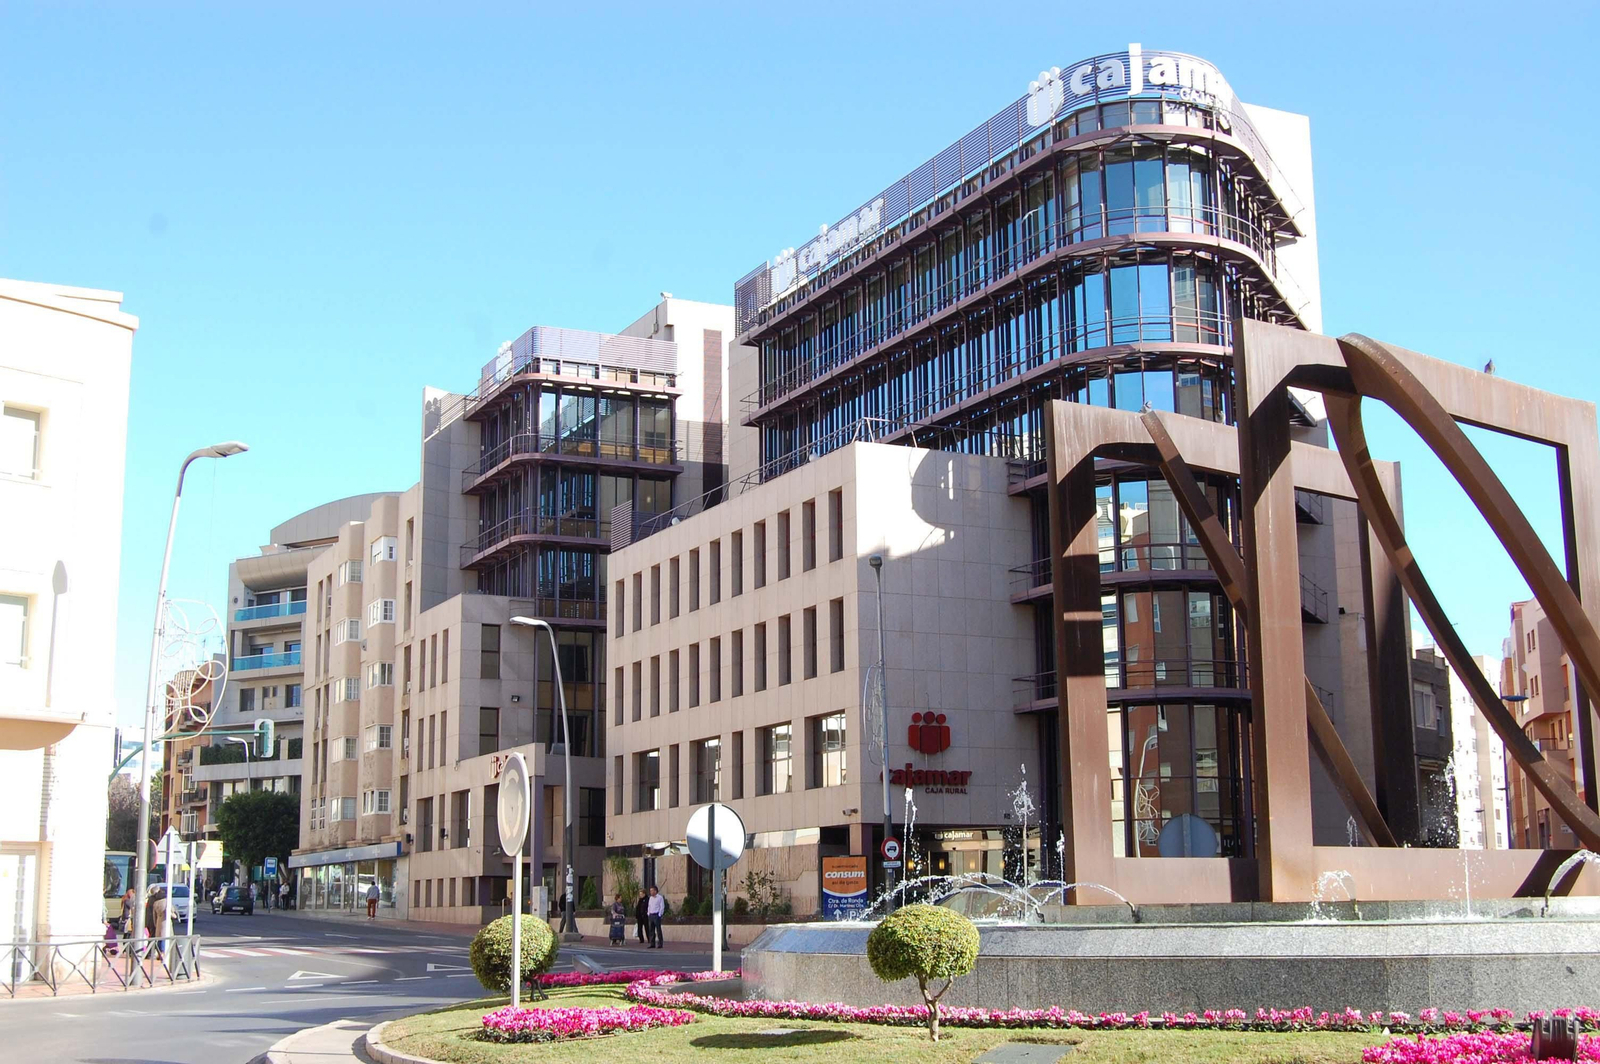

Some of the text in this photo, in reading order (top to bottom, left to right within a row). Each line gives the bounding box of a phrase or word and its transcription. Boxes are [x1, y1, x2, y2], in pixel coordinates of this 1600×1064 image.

[1070, 43, 1231, 108] cajam
[945, 787, 968, 795] RURAL
[944, 830, 974, 840] cajamar
[825, 871, 865, 879] consum
